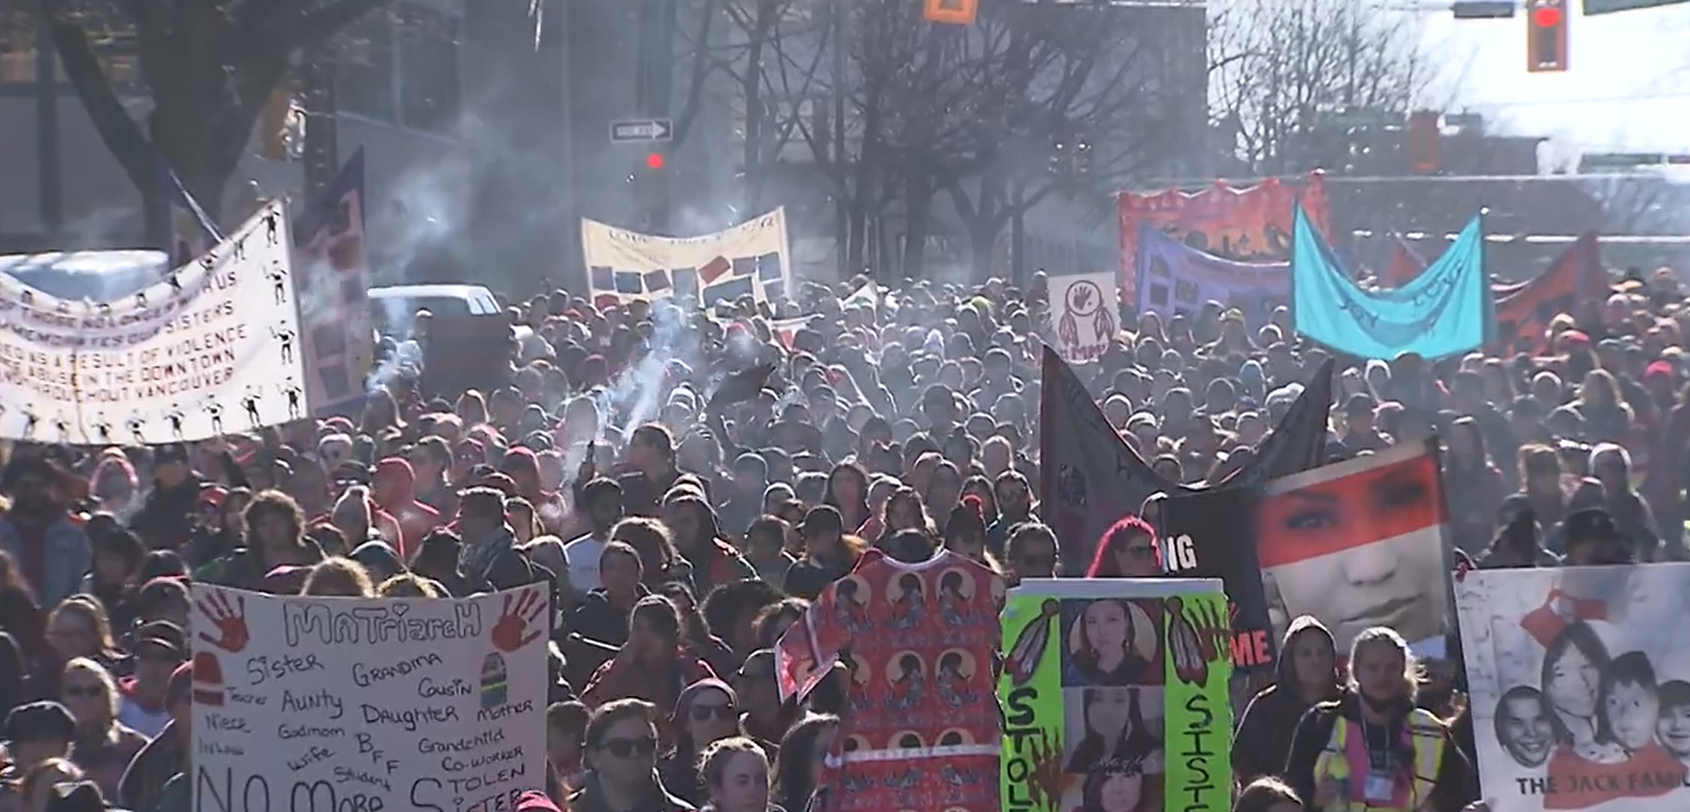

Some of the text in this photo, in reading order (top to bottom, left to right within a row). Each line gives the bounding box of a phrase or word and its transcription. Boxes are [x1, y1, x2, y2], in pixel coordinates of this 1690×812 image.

[213, 270, 237, 292] US
[164, 299, 234, 334] SISTERS
[68, 352, 136, 369] RESULT
[140, 346, 160, 365] OF
[166, 323, 248, 357] VIOLENCE
[104, 369, 136, 385] THE
[140, 346, 236, 382] DOWNTOWN
[135, 366, 234, 399] VANCOUVER
[352, 652, 443, 687] GRANDMA
[278, 723, 346, 739] Godmom
[418, 729, 505, 754] Grandchild
[1005, 686, 1041, 812] STOL
[1179, 694, 1216, 812] SIST
[196, 764, 270, 812] NO
[1516, 769, 1690, 795] THE JACK FAMIL
